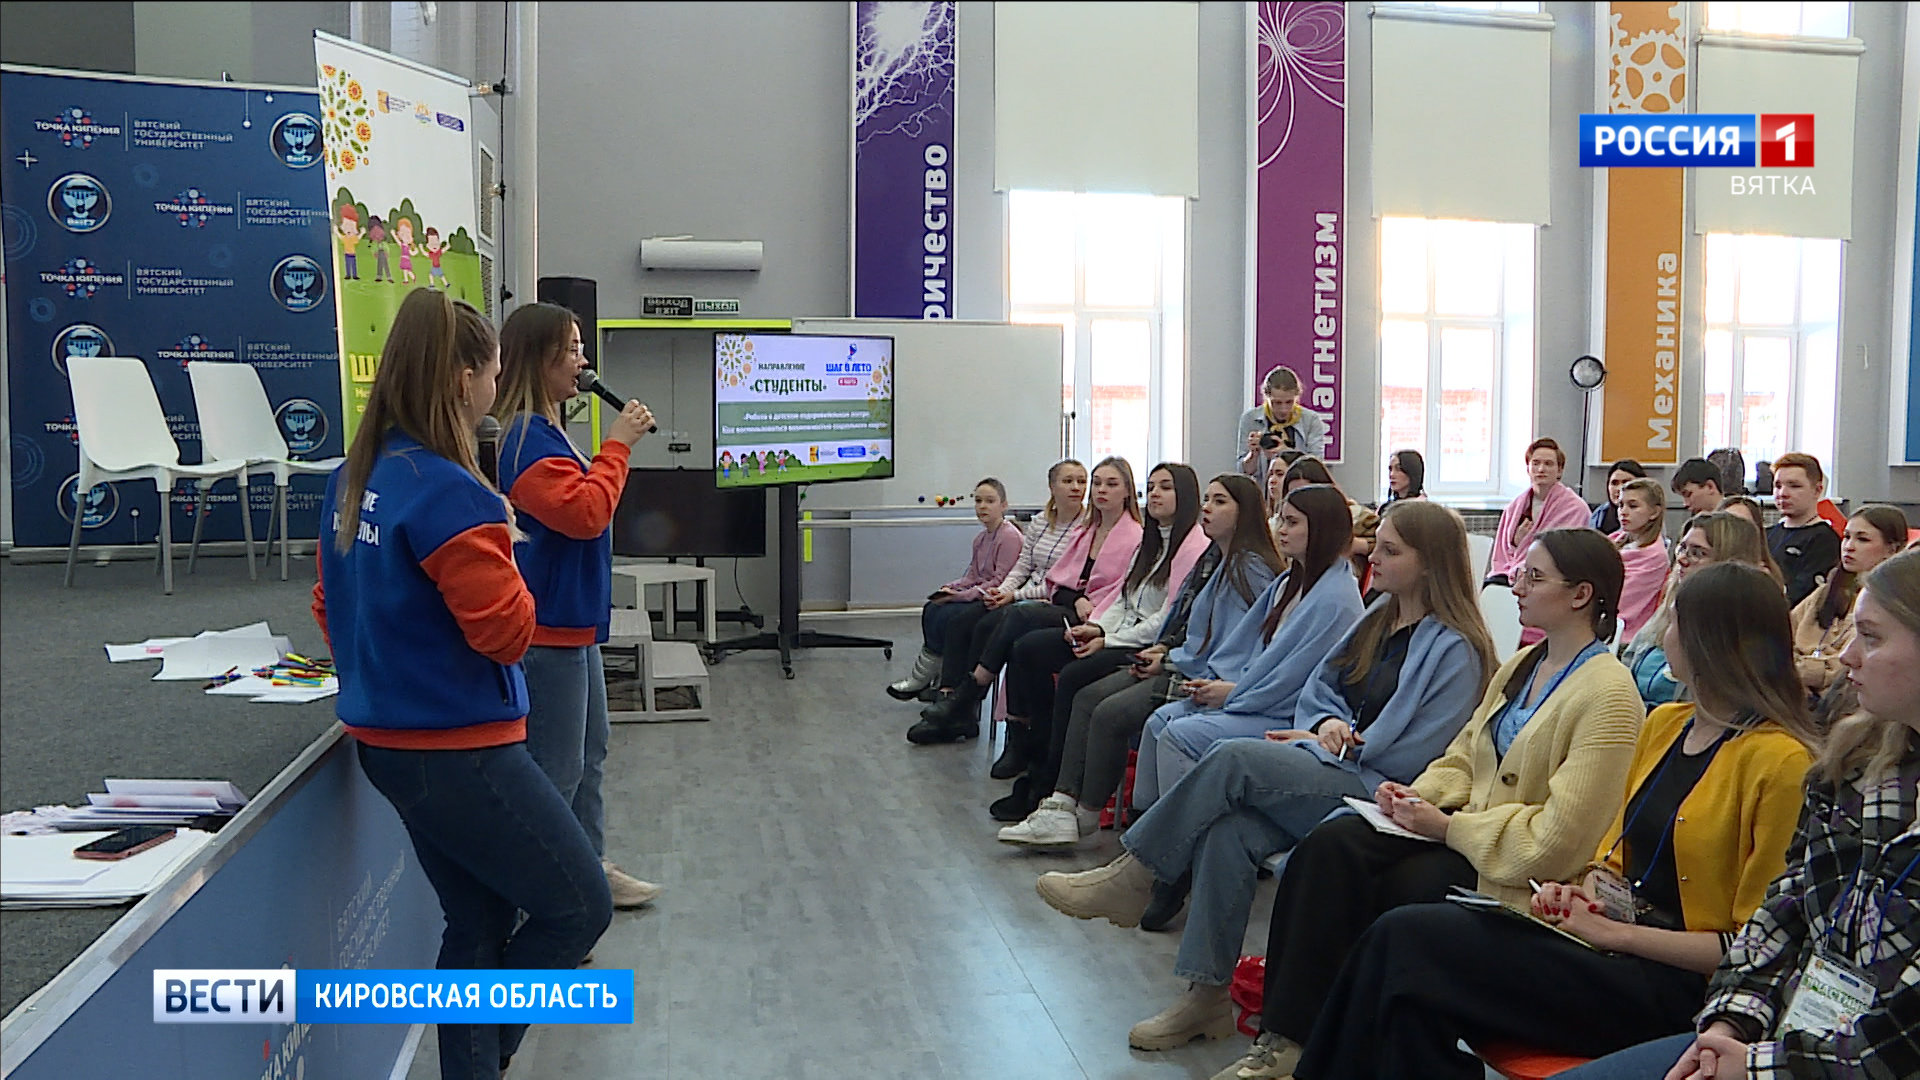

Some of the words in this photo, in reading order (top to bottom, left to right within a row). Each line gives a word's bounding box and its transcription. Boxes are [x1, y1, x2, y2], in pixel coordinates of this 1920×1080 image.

[35, 121, 71, 134] ТОЧКА
[72, 124, 120, 136] КИПЕНИЯ
[134, 120, 181, 130] ВЯТСКИЙ
[134, 129, 234, 142] ГОСУДАРСТВЕННЫЙ
[134, 139, 204, 150] УНИВЕРСИТЕТ
[154, 203, 188, 213] ТОЧКА
[189, 205, 233, 214] КИПЕНИЯ
[40, 273, 74, 284] ТОЧКА
[75, 274, 123, 285] КИПЕНИЯ
[655, 307, 681, 316] EXIT
[696, 302, 736, 311] ВЫХОД
[157, 350, 189, 359] ТОЧКА
[190, 351, 234, 360] КИПЕНИЯ
[1647, 252, 1677, 450] Механика
[758, 363, 806, 371] НАПРАВЛЕНИЕ
[826, 363, 843, 372] ШАГ
[852, 363, 871, 372] ЛЕТО
